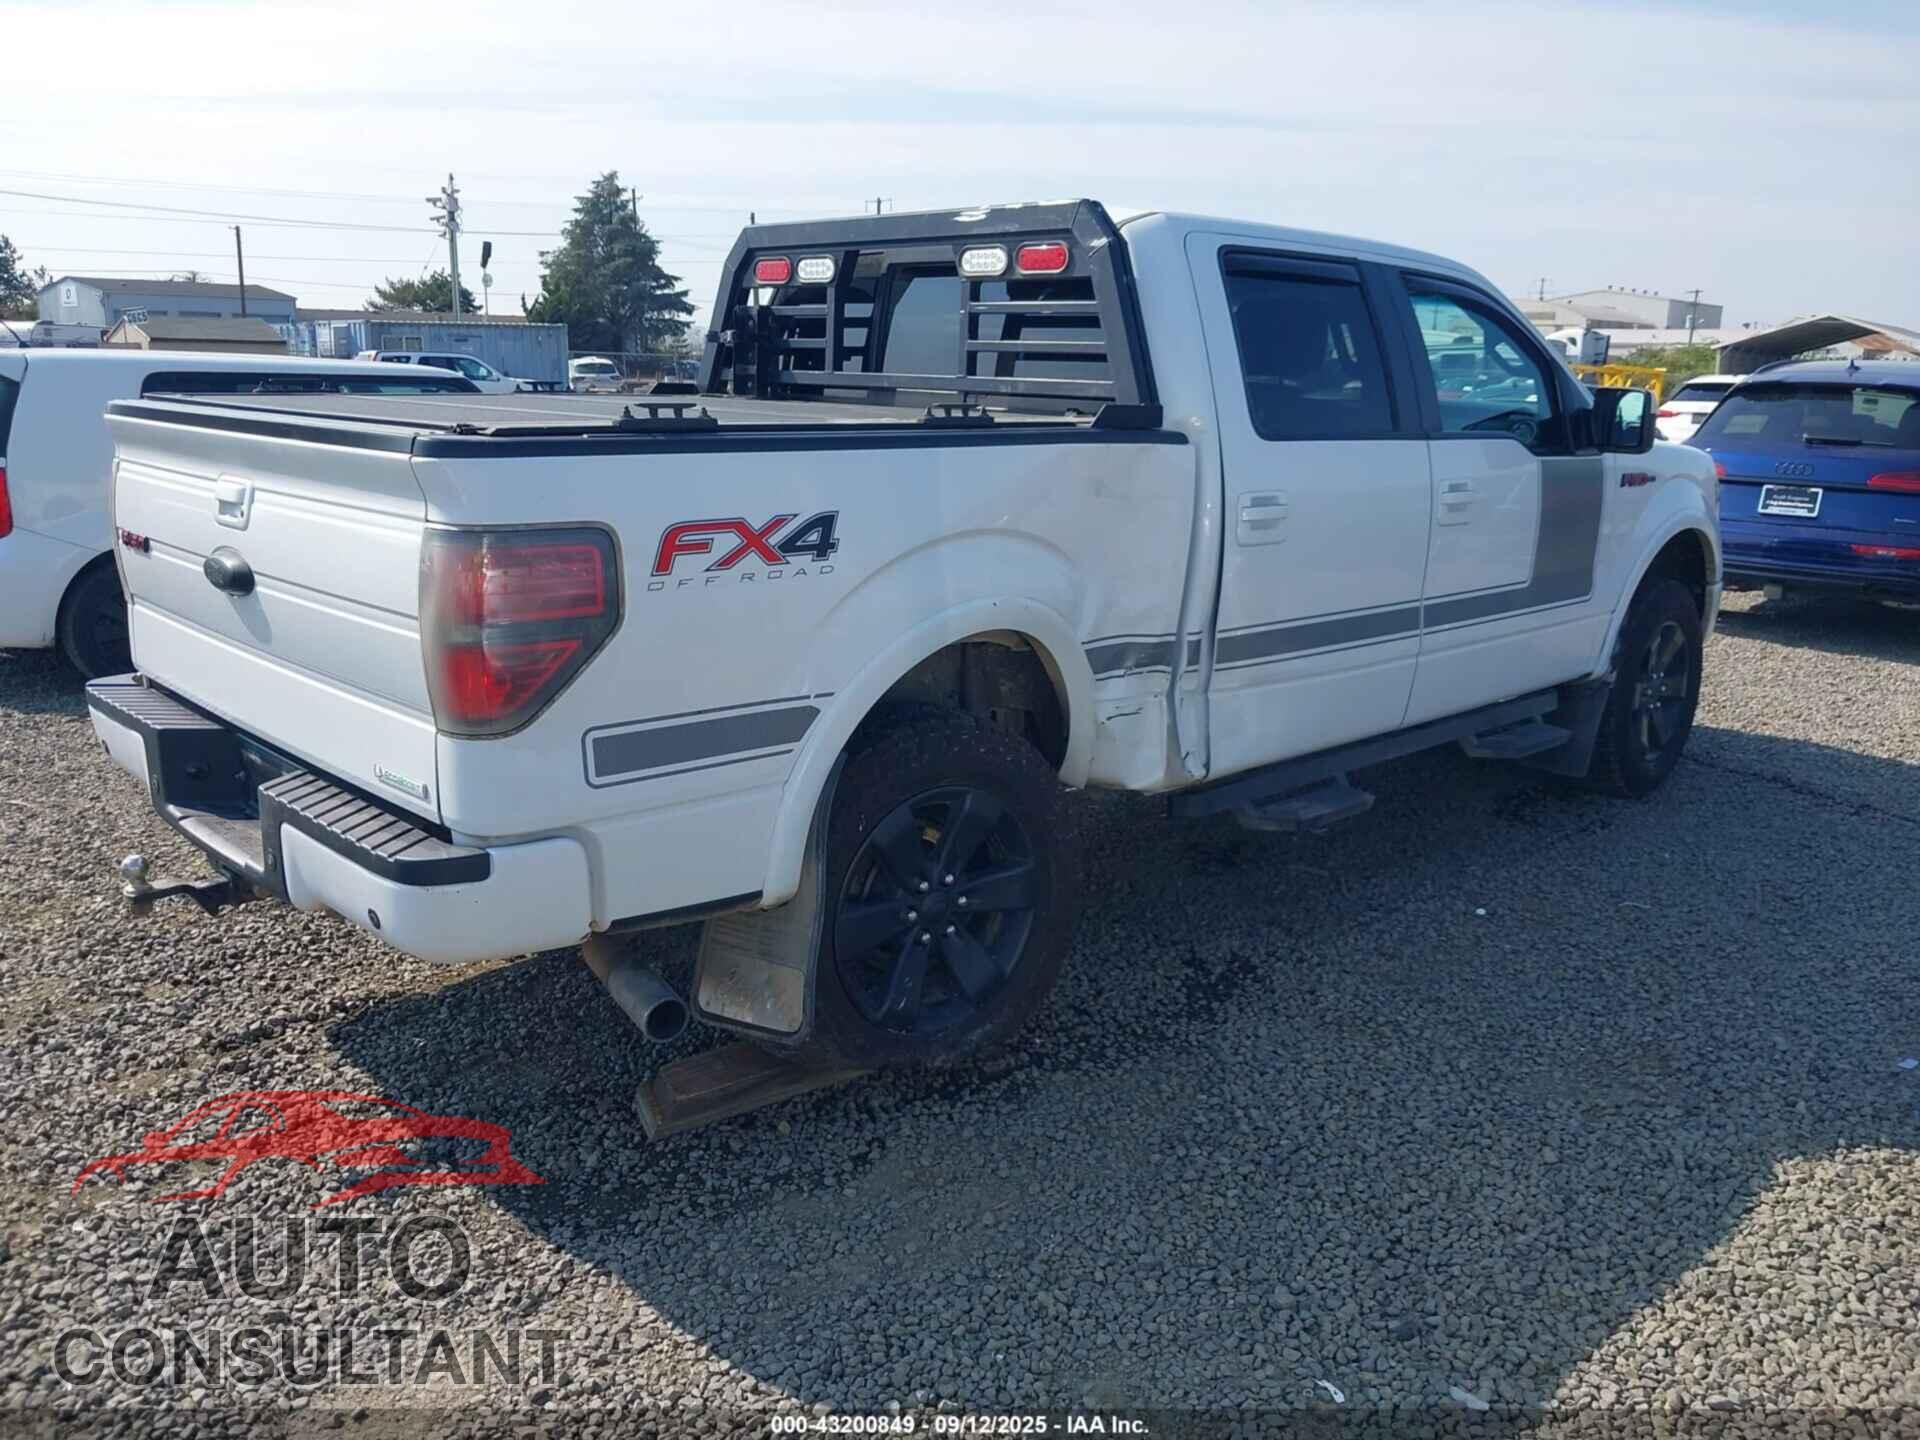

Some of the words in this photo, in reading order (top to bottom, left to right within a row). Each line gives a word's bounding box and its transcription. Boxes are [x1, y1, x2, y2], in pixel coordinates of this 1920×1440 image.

[651, 510, 840, 577] FX4
[647, 575, 721, 592] OFF
[739, 565, 835, 583] ROAD
